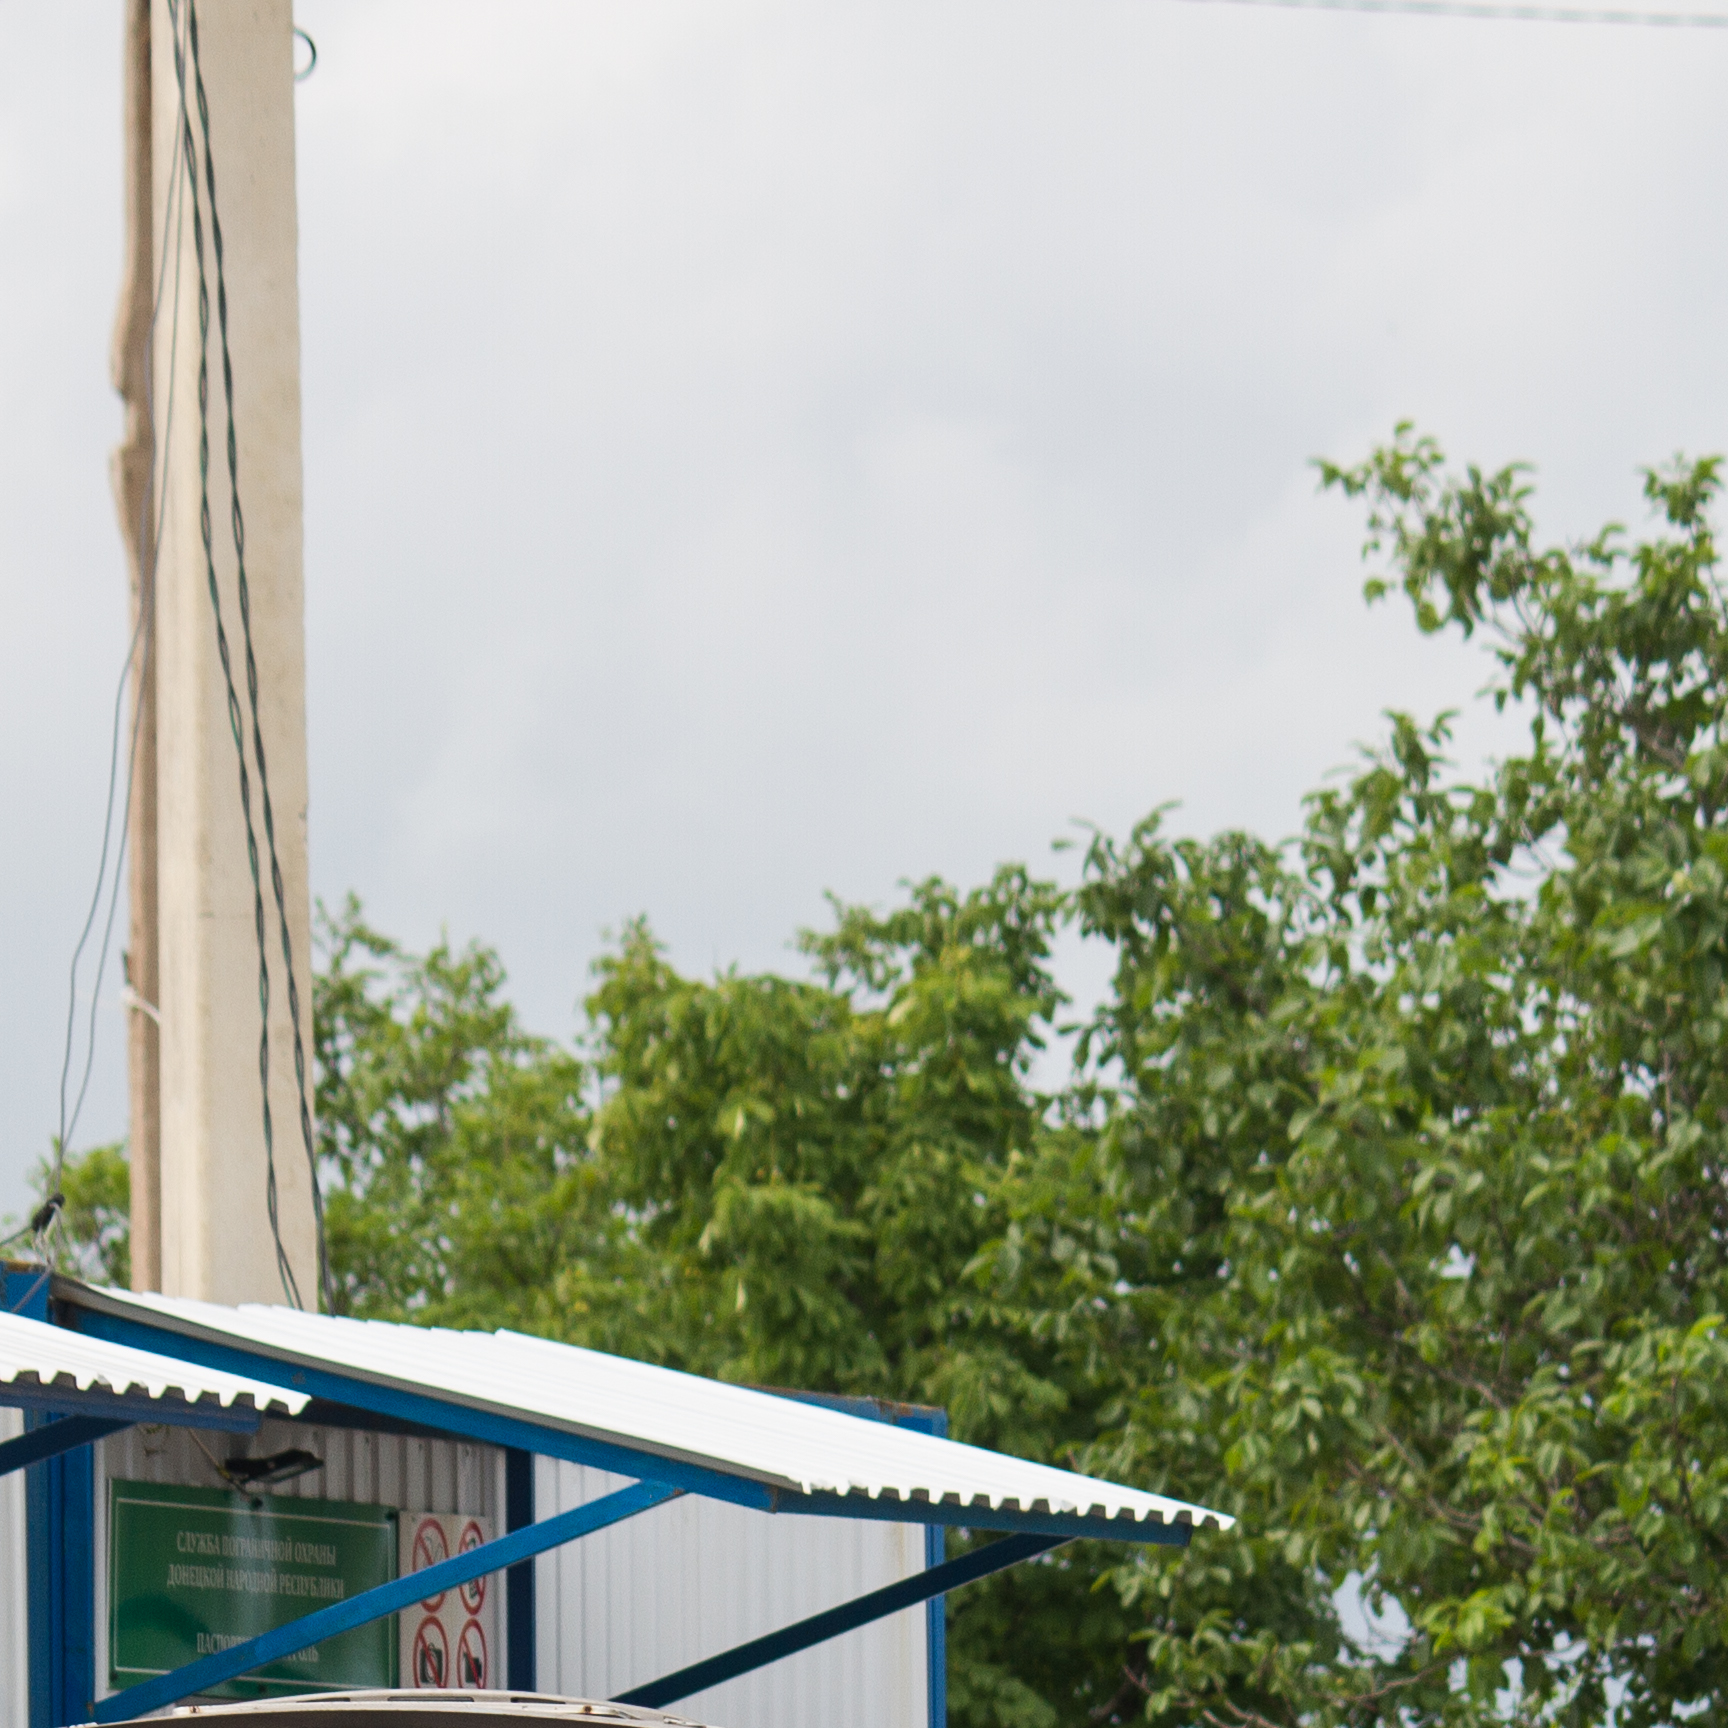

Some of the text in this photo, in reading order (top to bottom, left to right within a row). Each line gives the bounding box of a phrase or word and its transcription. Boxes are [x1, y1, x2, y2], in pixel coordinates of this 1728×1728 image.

[177, 1531, 337, 1567] СЛУЖБА ПОГРАНИЧНОЙ ОХРАНЫ
[167, 1563, 344, 1599] ДОНЕЦКОЙ НАРОДНОЙ РЕСПУБЛИКИ
